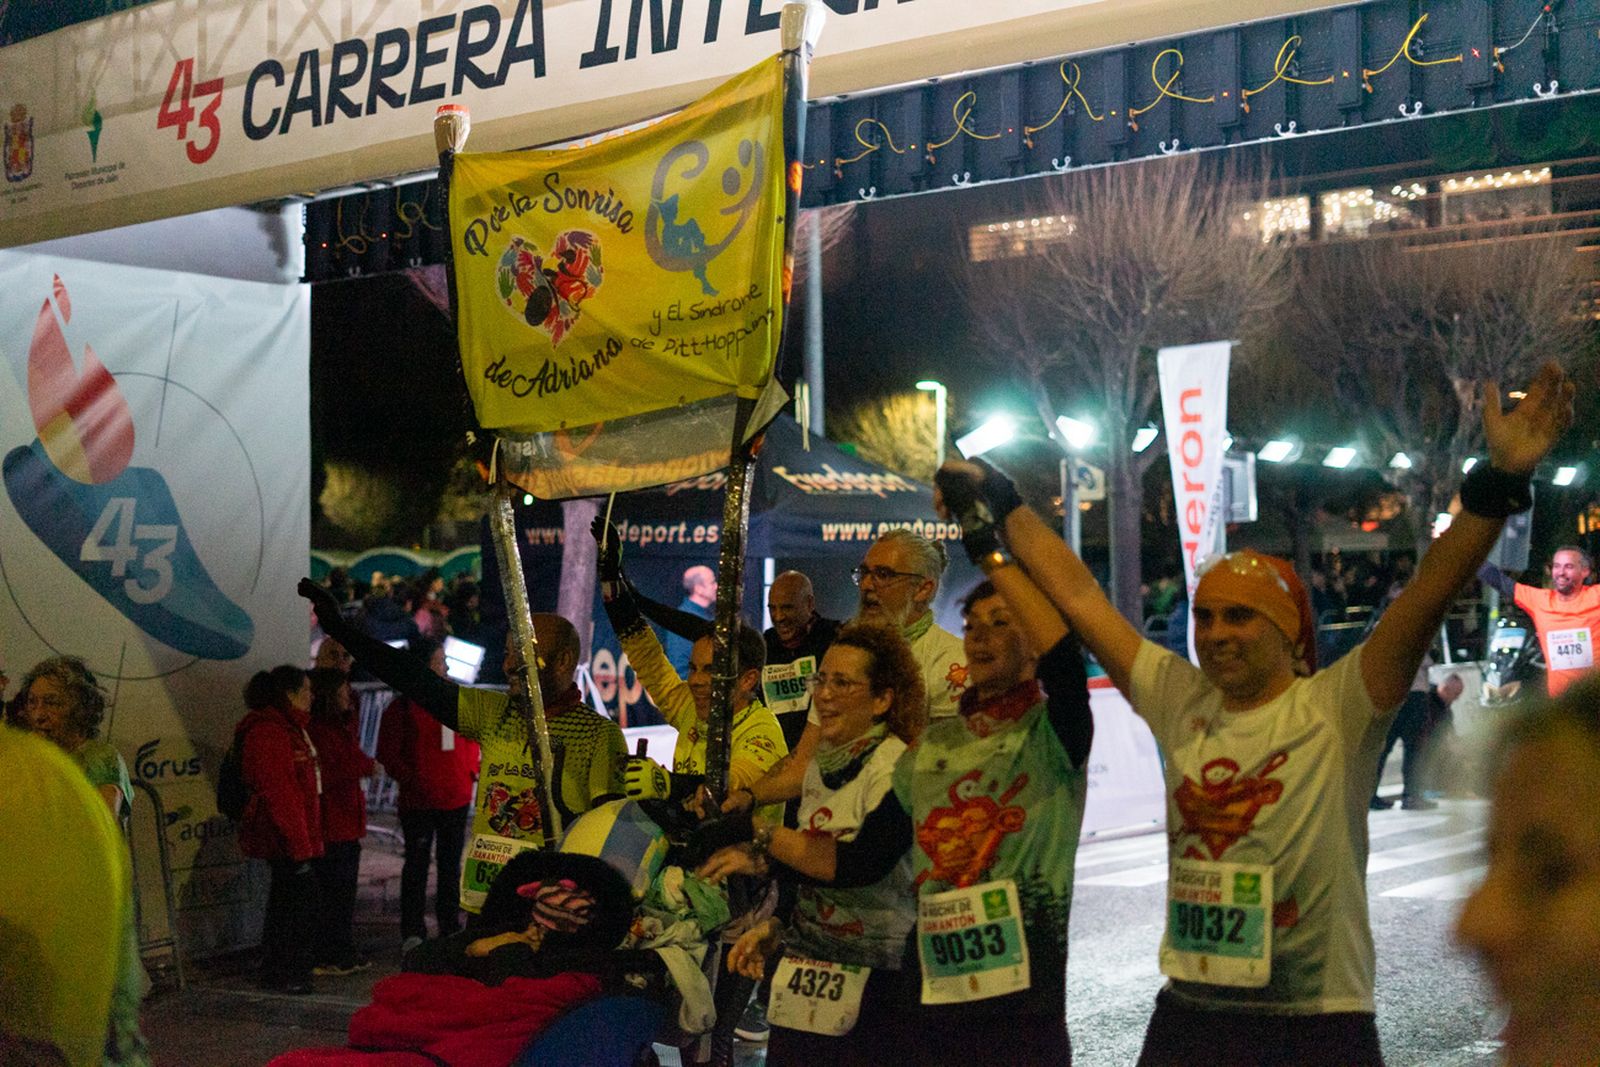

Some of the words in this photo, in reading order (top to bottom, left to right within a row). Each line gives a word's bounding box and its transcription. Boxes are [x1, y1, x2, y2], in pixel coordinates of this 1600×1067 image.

[157, 57, 225, 164] 43
[242, 0, 547, 141] CARRERA
[464, 205, 510, 257] Por
[508, 191, 538, 218] la
[543, 172, 634, 235] Sonrisa
[484, 355, 513, 389] de
[512, 337, 624, 398] Adriana
[80, 497, 179, 605] 43
[1557, 643, 1583, 656] 4478
[476, 860, 500, 885] 63
[930, 923, 1007, 966] 9033
[1177, 902, 1247, 944] 9032
[787, 967, 846, 1002] 4323
